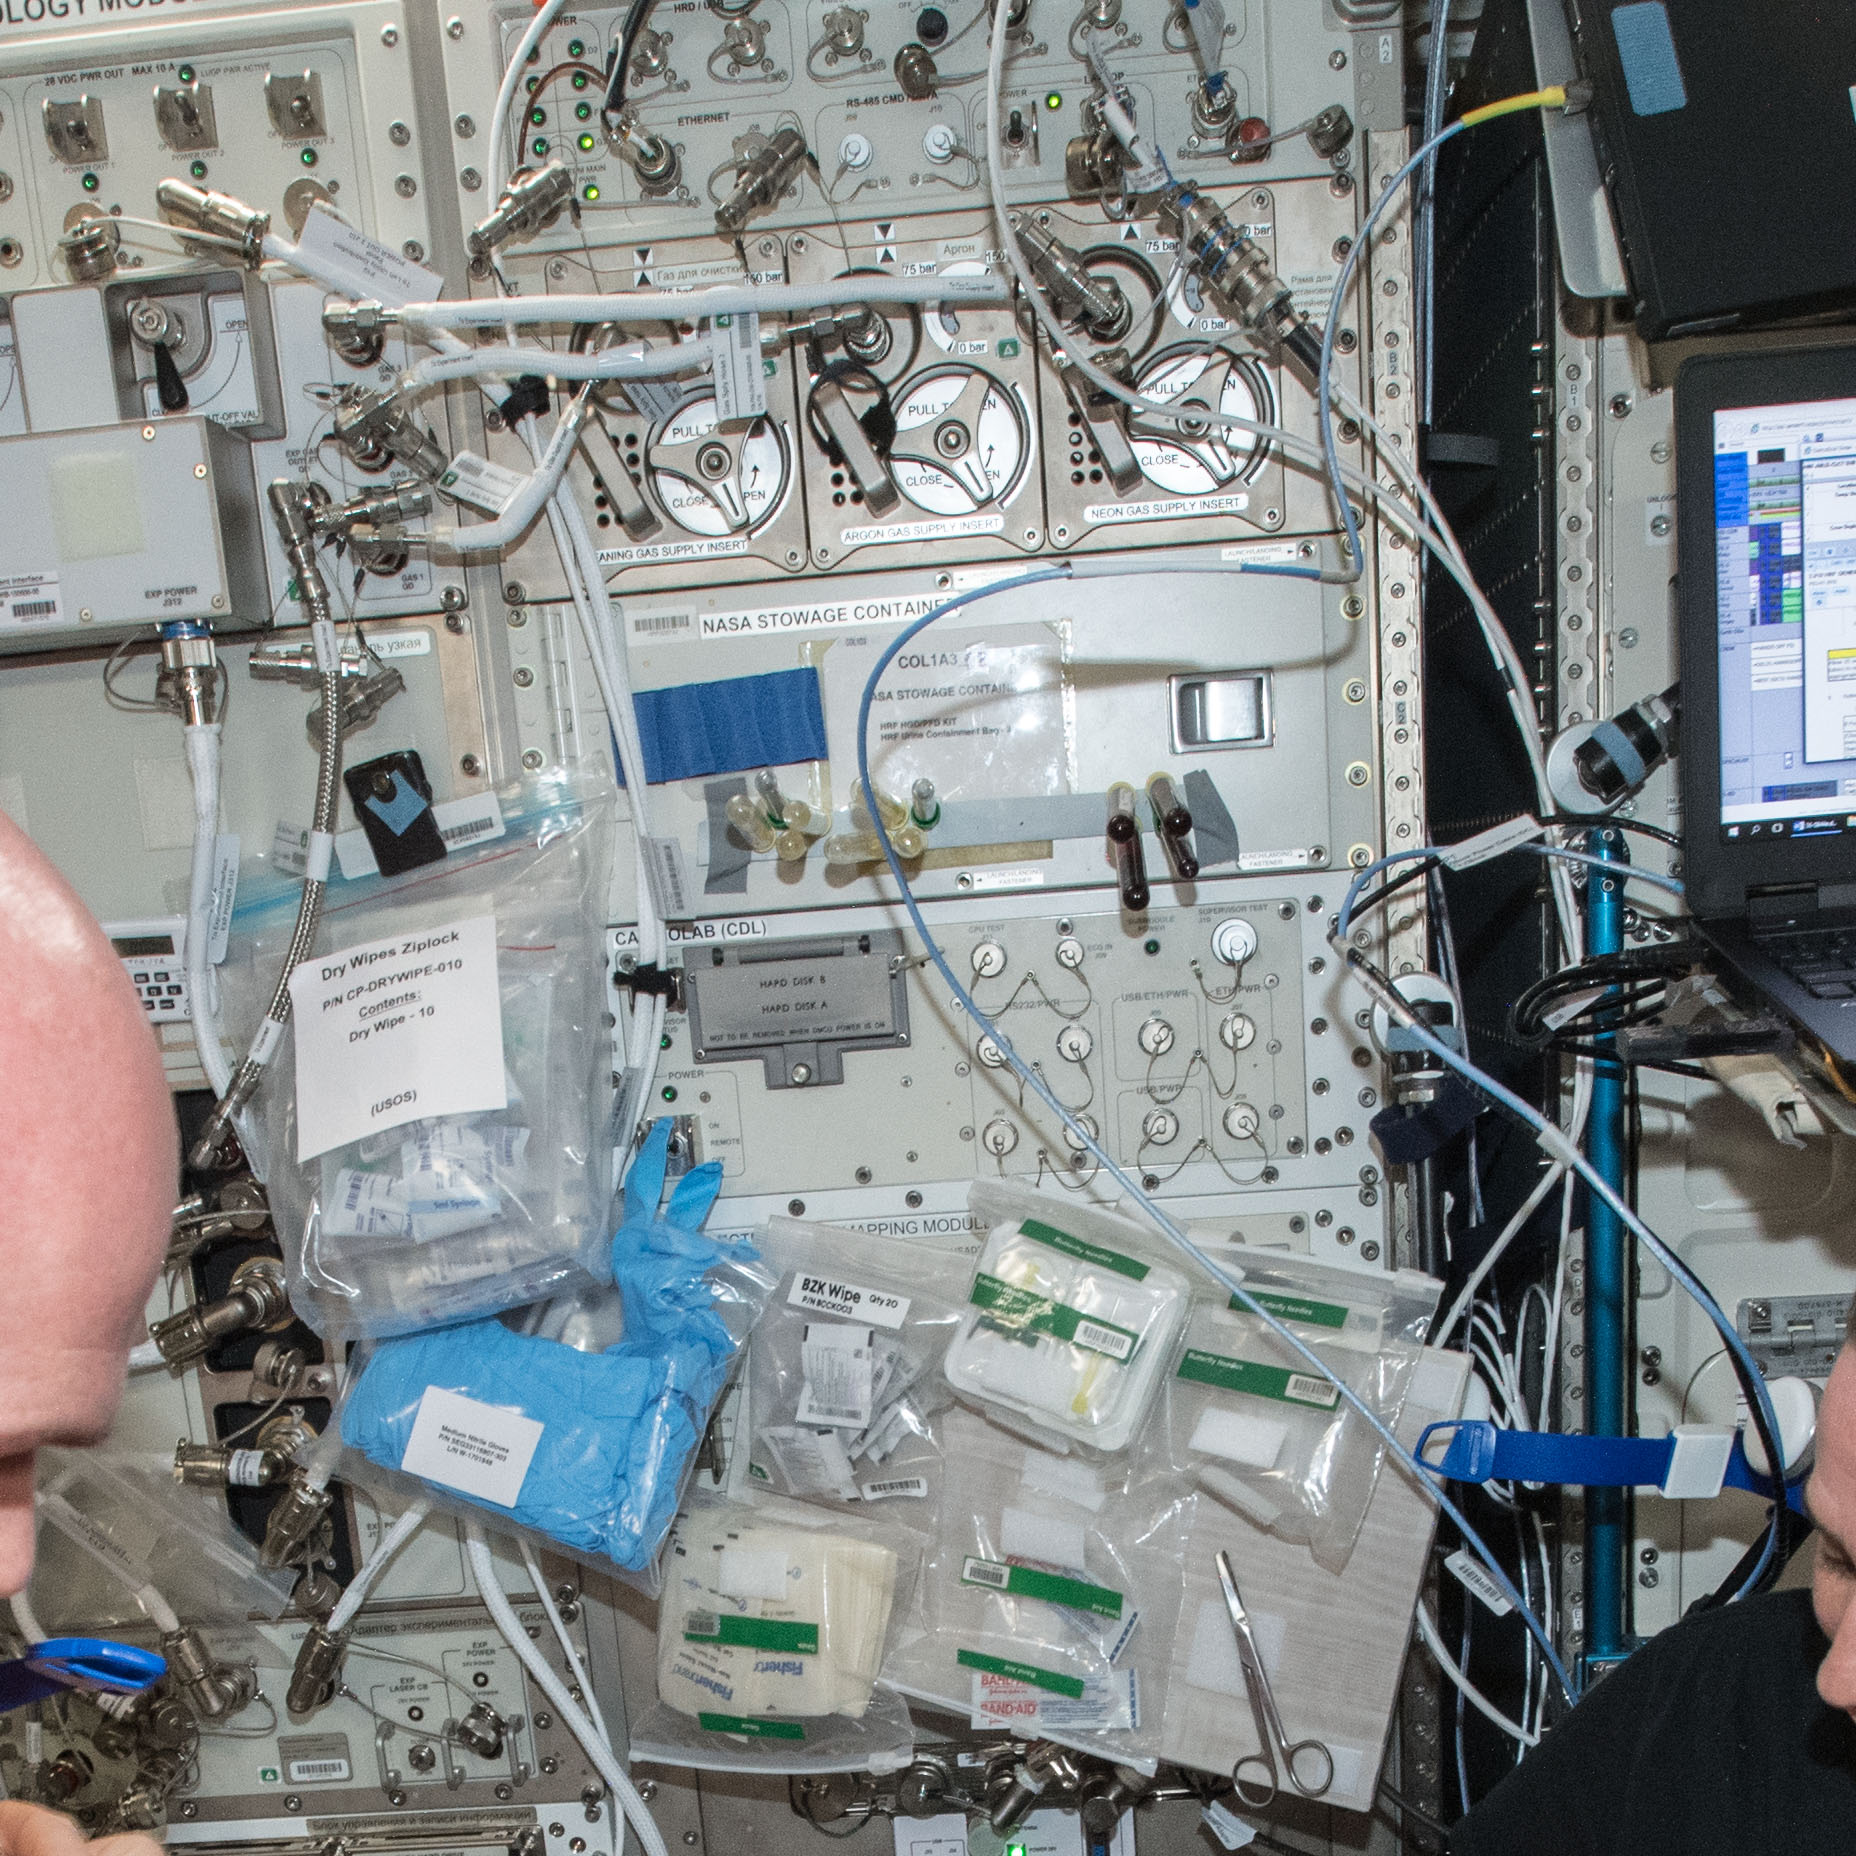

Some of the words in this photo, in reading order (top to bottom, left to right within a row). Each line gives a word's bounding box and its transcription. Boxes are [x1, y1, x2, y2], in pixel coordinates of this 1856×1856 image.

[58, 75, 76, 85] VDC
[80, 72, 101, 83] PWR
[105, 69, 124, 80] OUT
[132, 67, 152, 77] MAX
[846, 96, 880, 109] RS-485
[882, 93, 905, 106] CMD
[677, 112, 730, 126] ETHERNET
[1252, 223, 1271, 235] bar
[943, 242, 976, 257] Аргон
[1146, 240, 1158, 252] 75
[1160, 239, 1180, 251] bar
[701, 264, 744, 279] очистки
[903, 264, 915, 276] 75
[917, 262, 936, 275] bar
[765, 270, 783, 283] bar
[225, 319, 248, 330] OPEN
[1209, 317, 1228, 330] bar
[968, 341, 986, 353] bar
[909, 403, 936, 417] PULL
[673, 427, 702, 439] PULL
[1142, 453, 1178, 466] CLOSE
[906, 474, 942, 487] CLOSE
[673, 496, 707, 509] CLOSE
[1091, 506, 1125, 519] NEON
[1128, 504, 1150, 517] GAS
[1153, 500, 1195, 515] SUPPLY
[1198, 496, 1240, 511] INSERT
[844, 528, 884, 543] ARGON
[887, 526, 910, 540] GAS
[912, 523, 954, 538] SUPPLY
[958, 518, 1002, 533] INSERT
[633, 547, 658, 560] GAS
[662, 544, 702, 558] SUPPLY
[707, 540, 746, 553] INSERT
[145, 589, 165, 600] EXP
[167, 586, 197, 598] POWER
[703, 615, 752, 635] NASA
[758, 606, 847, 630] STOWAGE
[388, 638, 422, 653] узкая
[898, 653, 958, 670] COL1A3
[897, 687, 955, 702] STOWAGE
[926, 727, 980, 741] Containment
[1198, 907, 1243, 917] SUPERVISOR
[1247, 904, 1268, 914] TEST
[721, 919, 767, 938] (CDL)
[322, 963, 346, 983] Dry
[350, 948, 396, 971] Wipes
[402, 931, 460, 956] Ziplock
[323, 994, 344, 1013] P/N
[347, 958, 462, 1003] CP-DRYWIPE-010
[760, 978, 786, 989] HARD
[793, 976, 815, 987] DISK
[1121, 989, 1189, 1003] USB/ETH/PWR
[1216, 984, 1261, 996] ETH/PWR
[359, 989, 422, 1020] Contents:
[762, 1003, 789, 1015] HARD
[795, 1001, 816, 1012] DISK
[349, 1024, 370, 1044] Dry
[374, 1013, 406, 1034] Wipe
[419, 1005, 435, 1019] 10
[668, 1069, 704, 1080] POWER
[1136, 1083, 1182, 1095] USB/PWR
[370, 1089, 417, 1118] (USOS)
[711, 1138, 740, 1147] REMOTE
[802, 1277, 825, 1295] BZK
[828, 1283, 861, 1304] Wipe
[869, 1294, 884, 1307] Qty
[886, 1296, 898, 1308] 20
[441, 1425, 466, 1439] Medium
[488, 1441, 510, 1455] Gloves
[349, 1622, 397, 1638] Адаптер
[466, 1646, 496, 1657] POWER
[389, 1684, 414, 1693] LASER
